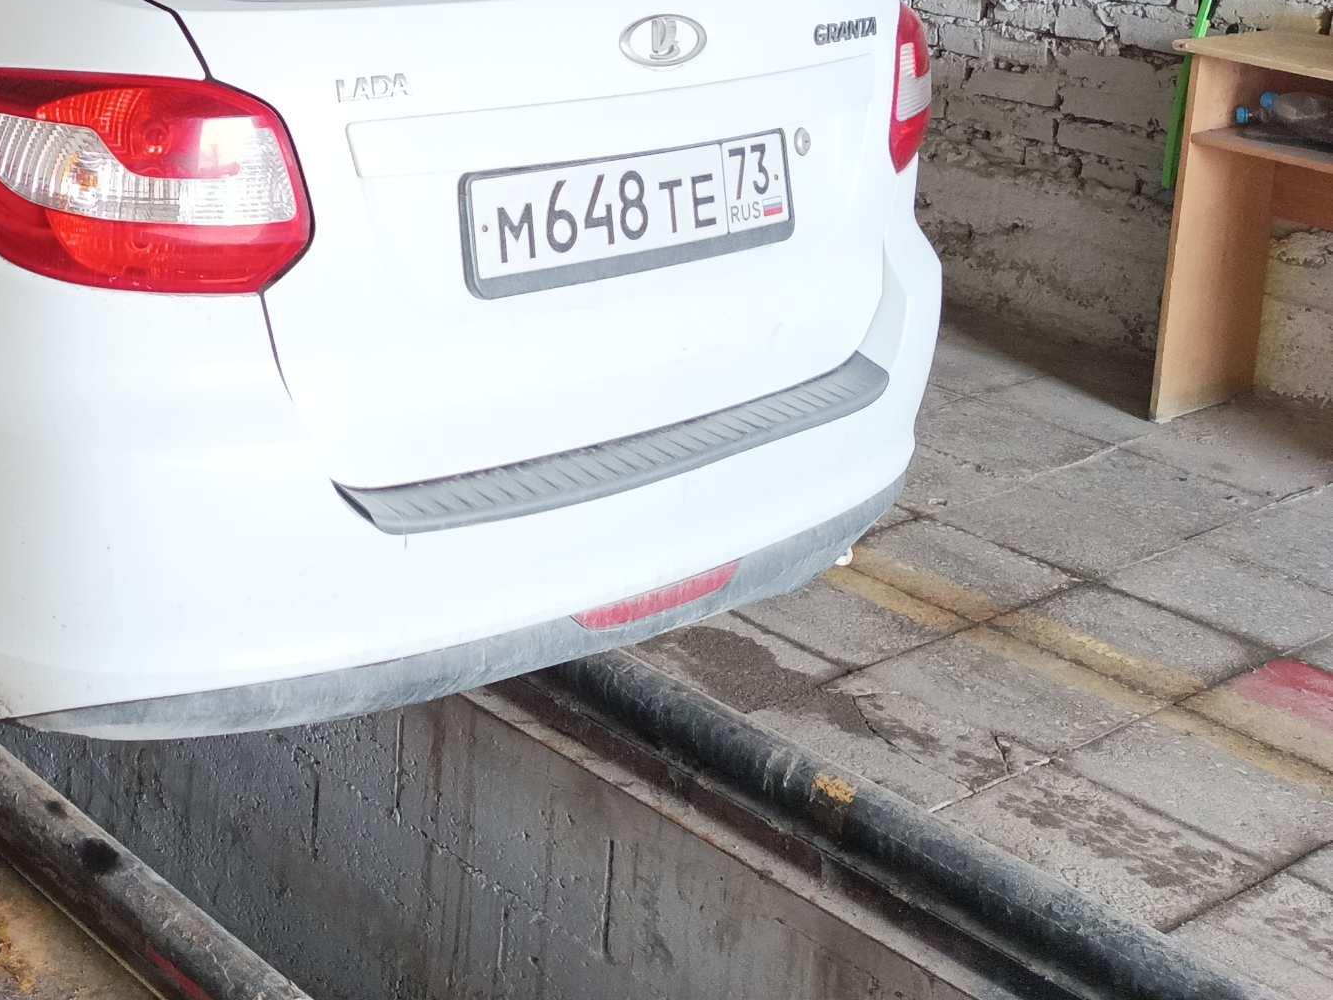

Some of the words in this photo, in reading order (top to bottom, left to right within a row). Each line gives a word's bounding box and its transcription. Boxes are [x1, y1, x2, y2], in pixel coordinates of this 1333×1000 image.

[813, 16, 877, 46] GRANTA
[335, 72, 409, 103] LADA
[727, 143, 770, 201] 73
[730, 201, 762, 224] RUS
